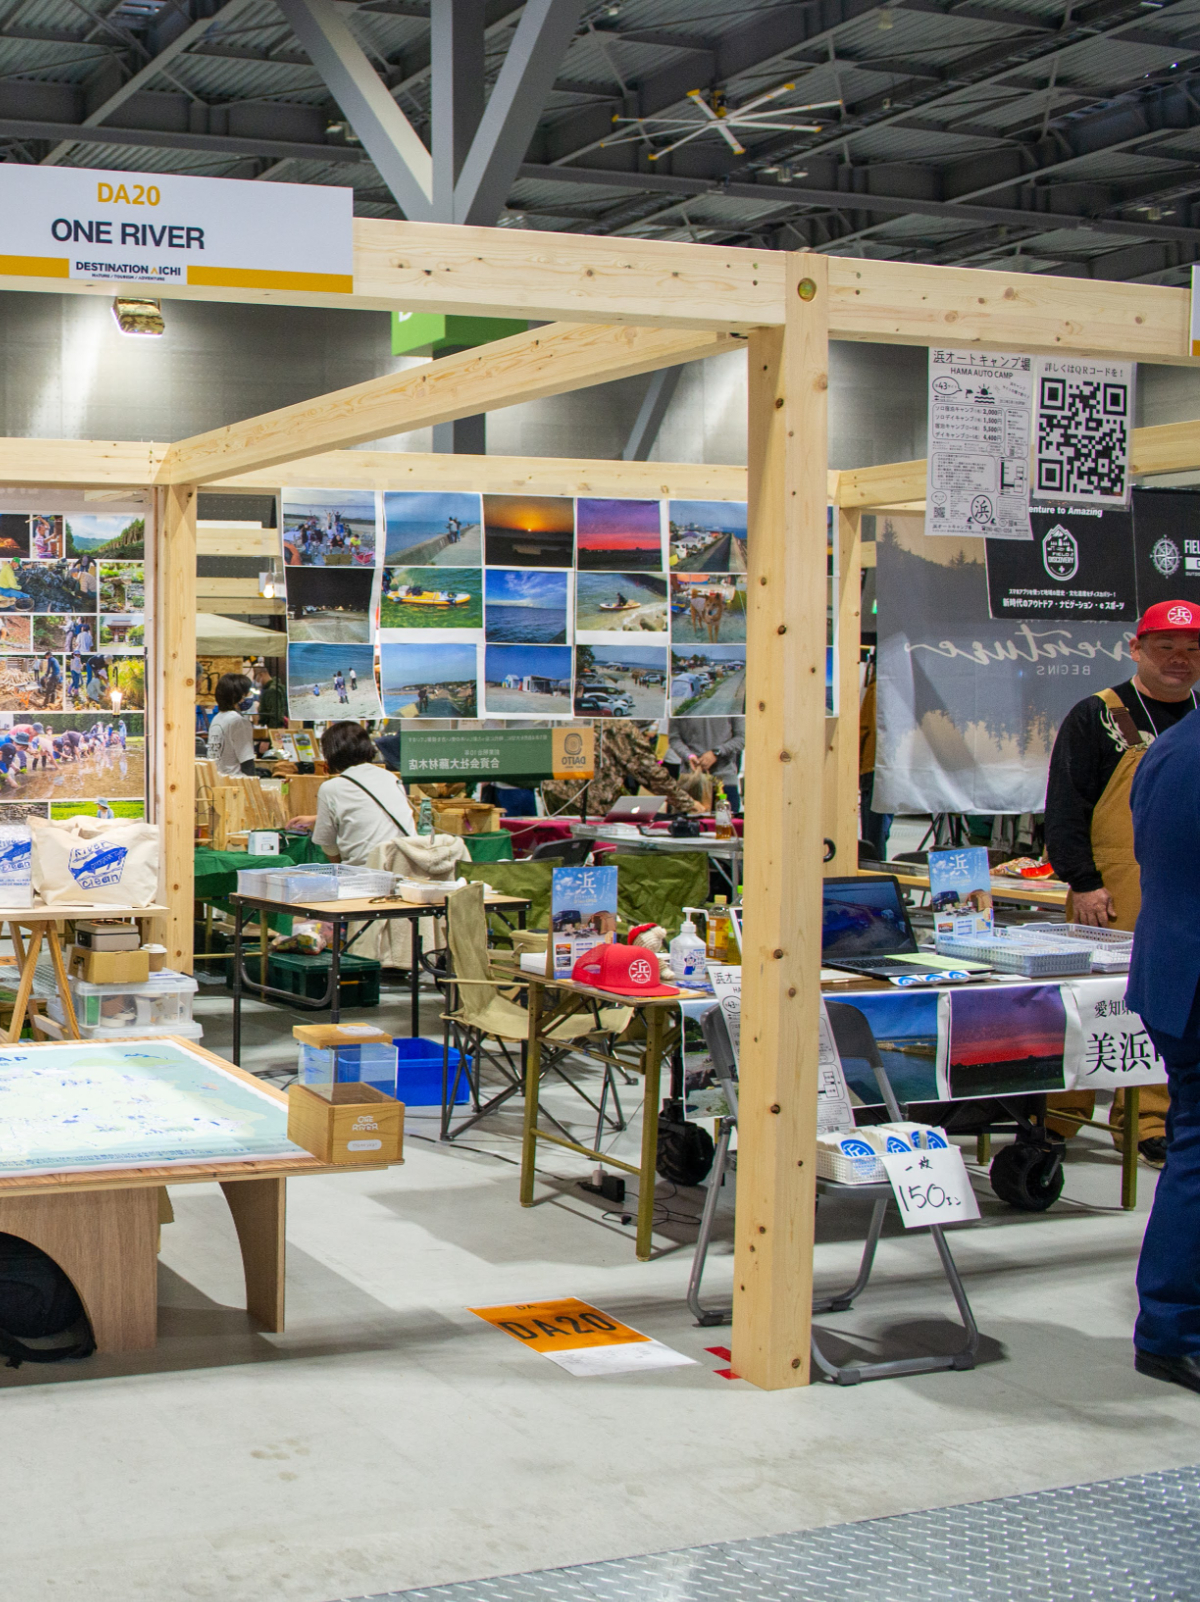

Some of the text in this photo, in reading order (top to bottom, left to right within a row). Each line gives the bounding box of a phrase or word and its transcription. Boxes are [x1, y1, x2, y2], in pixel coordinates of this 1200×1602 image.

[97, 182, 161, 207] DA20
[51, 218, 205, 250] ONE RIVER
[76, 261, 181, 276] DESTINATION AICHI
[933, 350, 1031, 371] 浜オートキャンプ場
[950, 367, 1014, 379] HAMA AUTO CAMP
[973, 499, 990, 519] 浜
[1028, 506, 1103, 518] enture to Amazing
[1169, 606, 1192, 623] 浜
[949, 854, 969, 876] 浜
[575, 871, 597, 895] 浜
[630, 960, 650, 980] 浜
[1085, 1029, 1162, 1076] 美浜
[905, 1156, 933, 1172] 一枚
[498, 1312, 618, 1341] DA20
